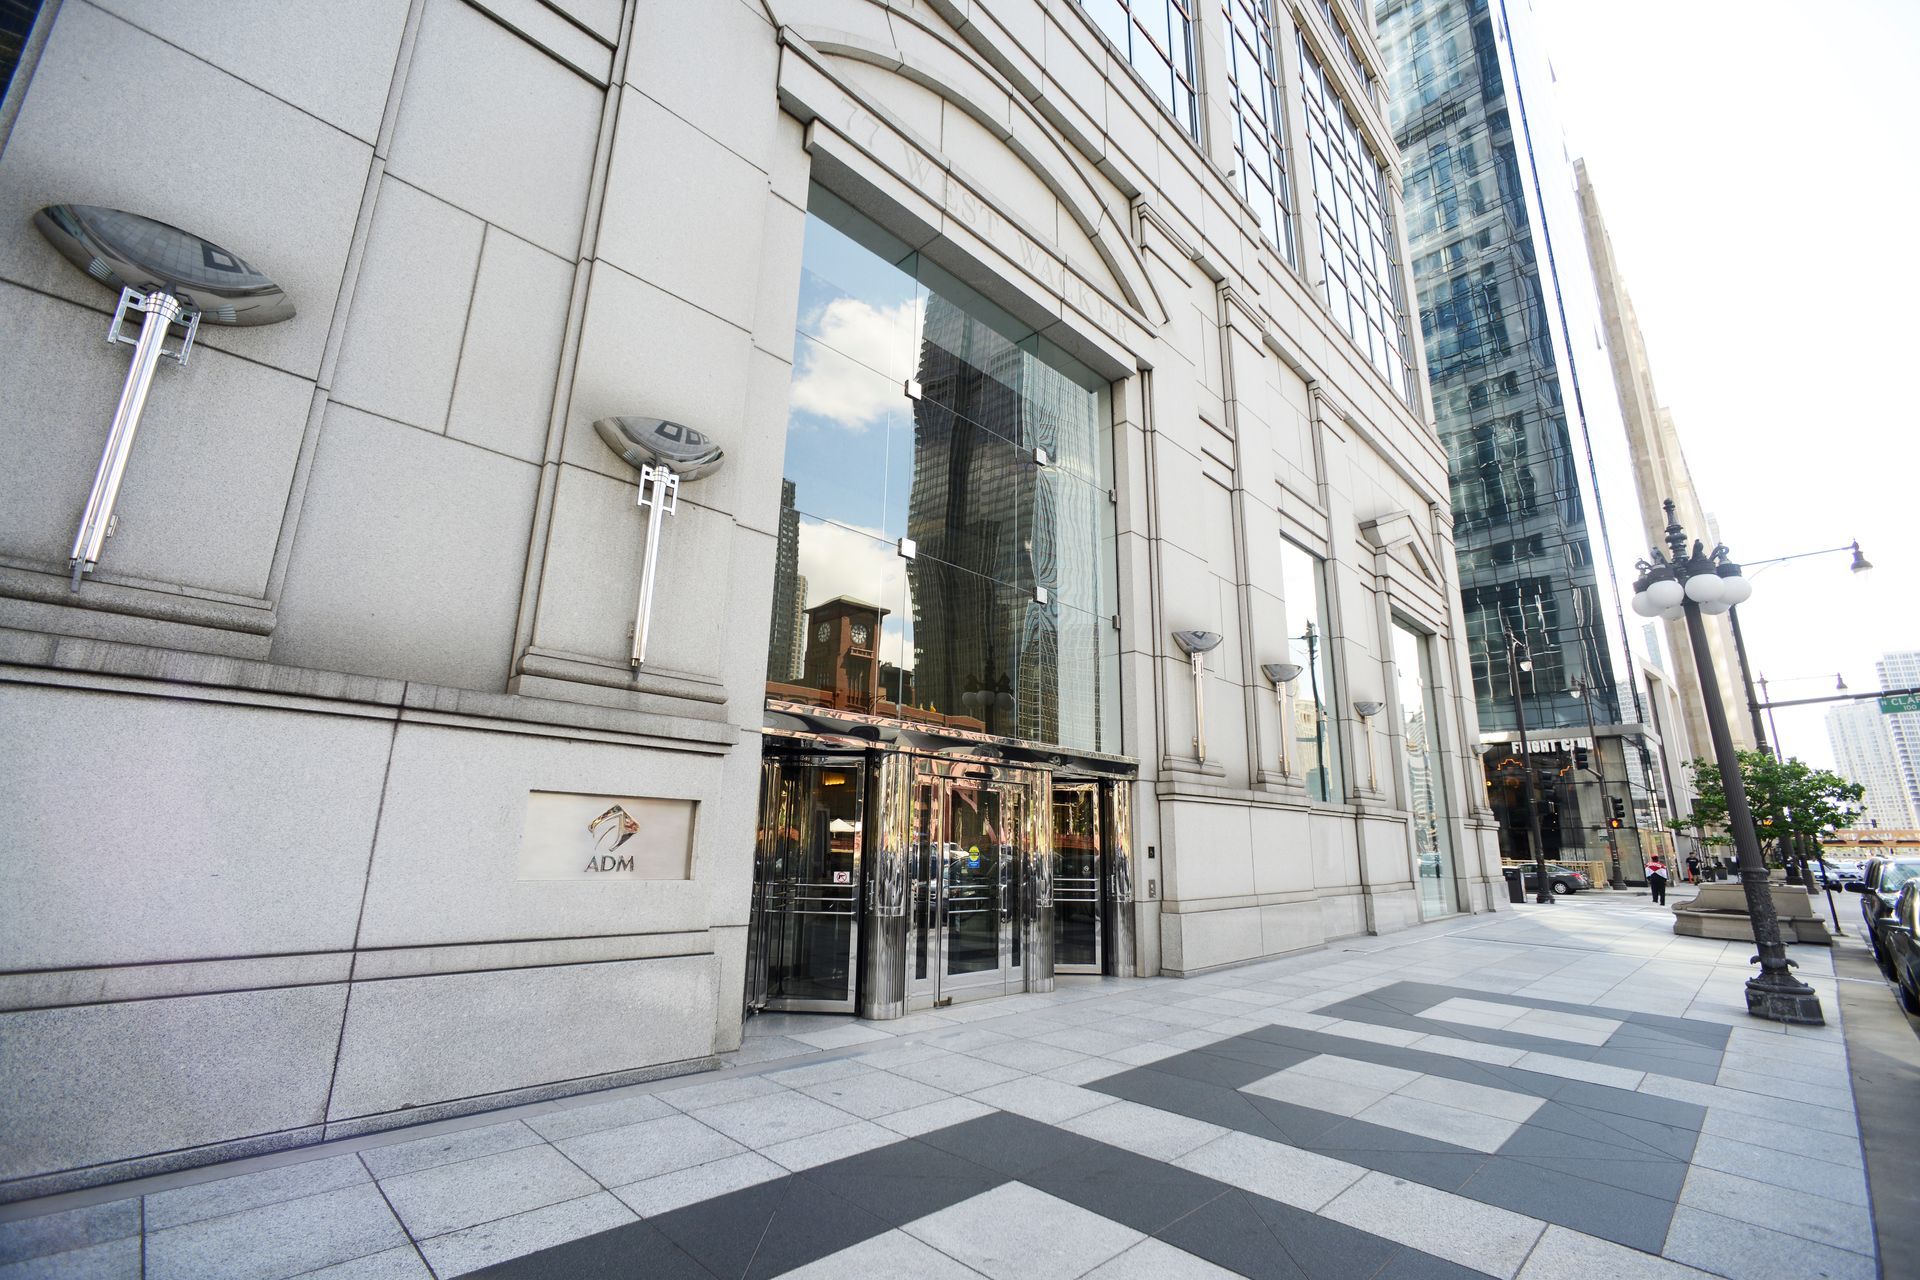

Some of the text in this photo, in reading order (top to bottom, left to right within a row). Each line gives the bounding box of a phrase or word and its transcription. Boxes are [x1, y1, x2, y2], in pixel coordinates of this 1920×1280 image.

[840, 97, 1128, 342] 77 WEST WACKER
[584, 855, 635, 872] ADM
